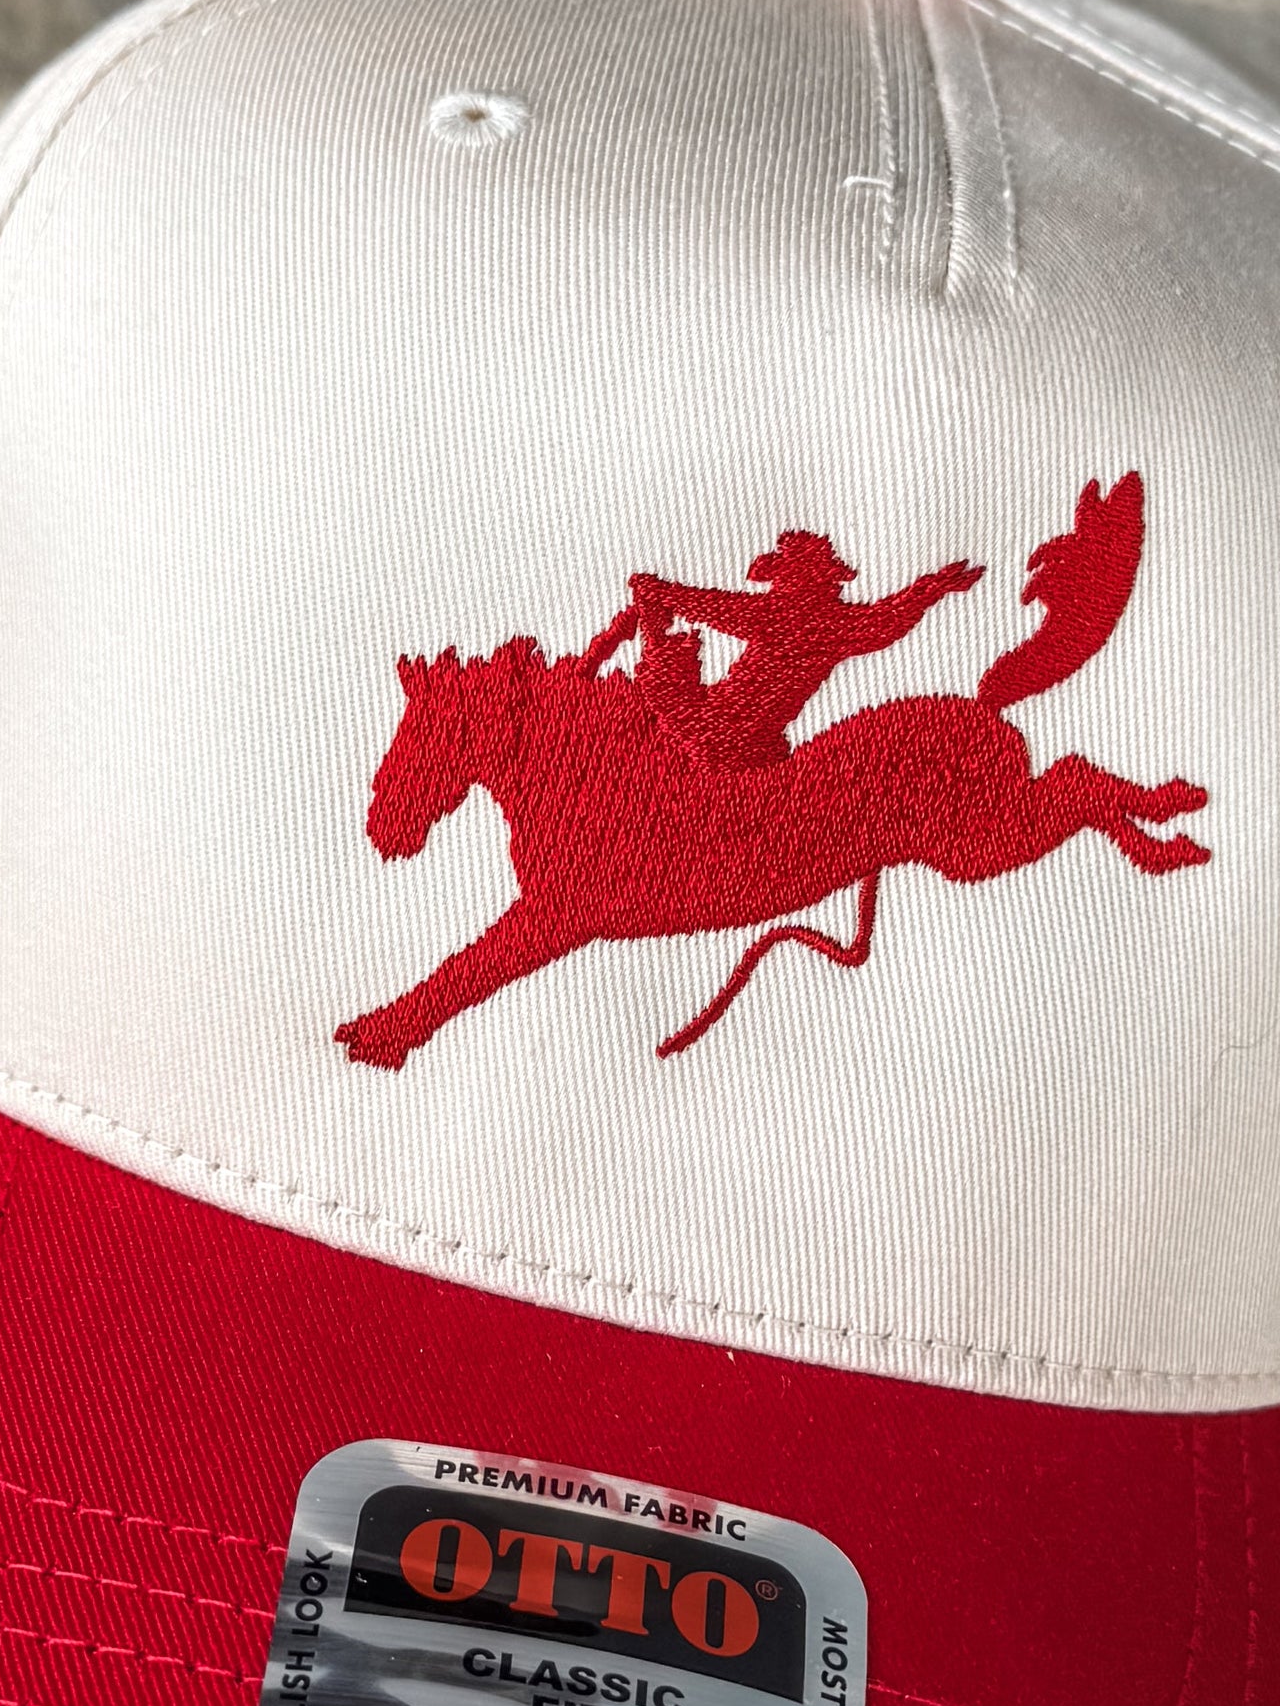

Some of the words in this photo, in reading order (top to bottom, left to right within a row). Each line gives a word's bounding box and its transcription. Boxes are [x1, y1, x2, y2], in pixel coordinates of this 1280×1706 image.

[434, 1458, 609, 1509] PREMIUM
[622, 1491, 749, 1543] FABRIC
[292, 1548, 335, 1638] LOOK
